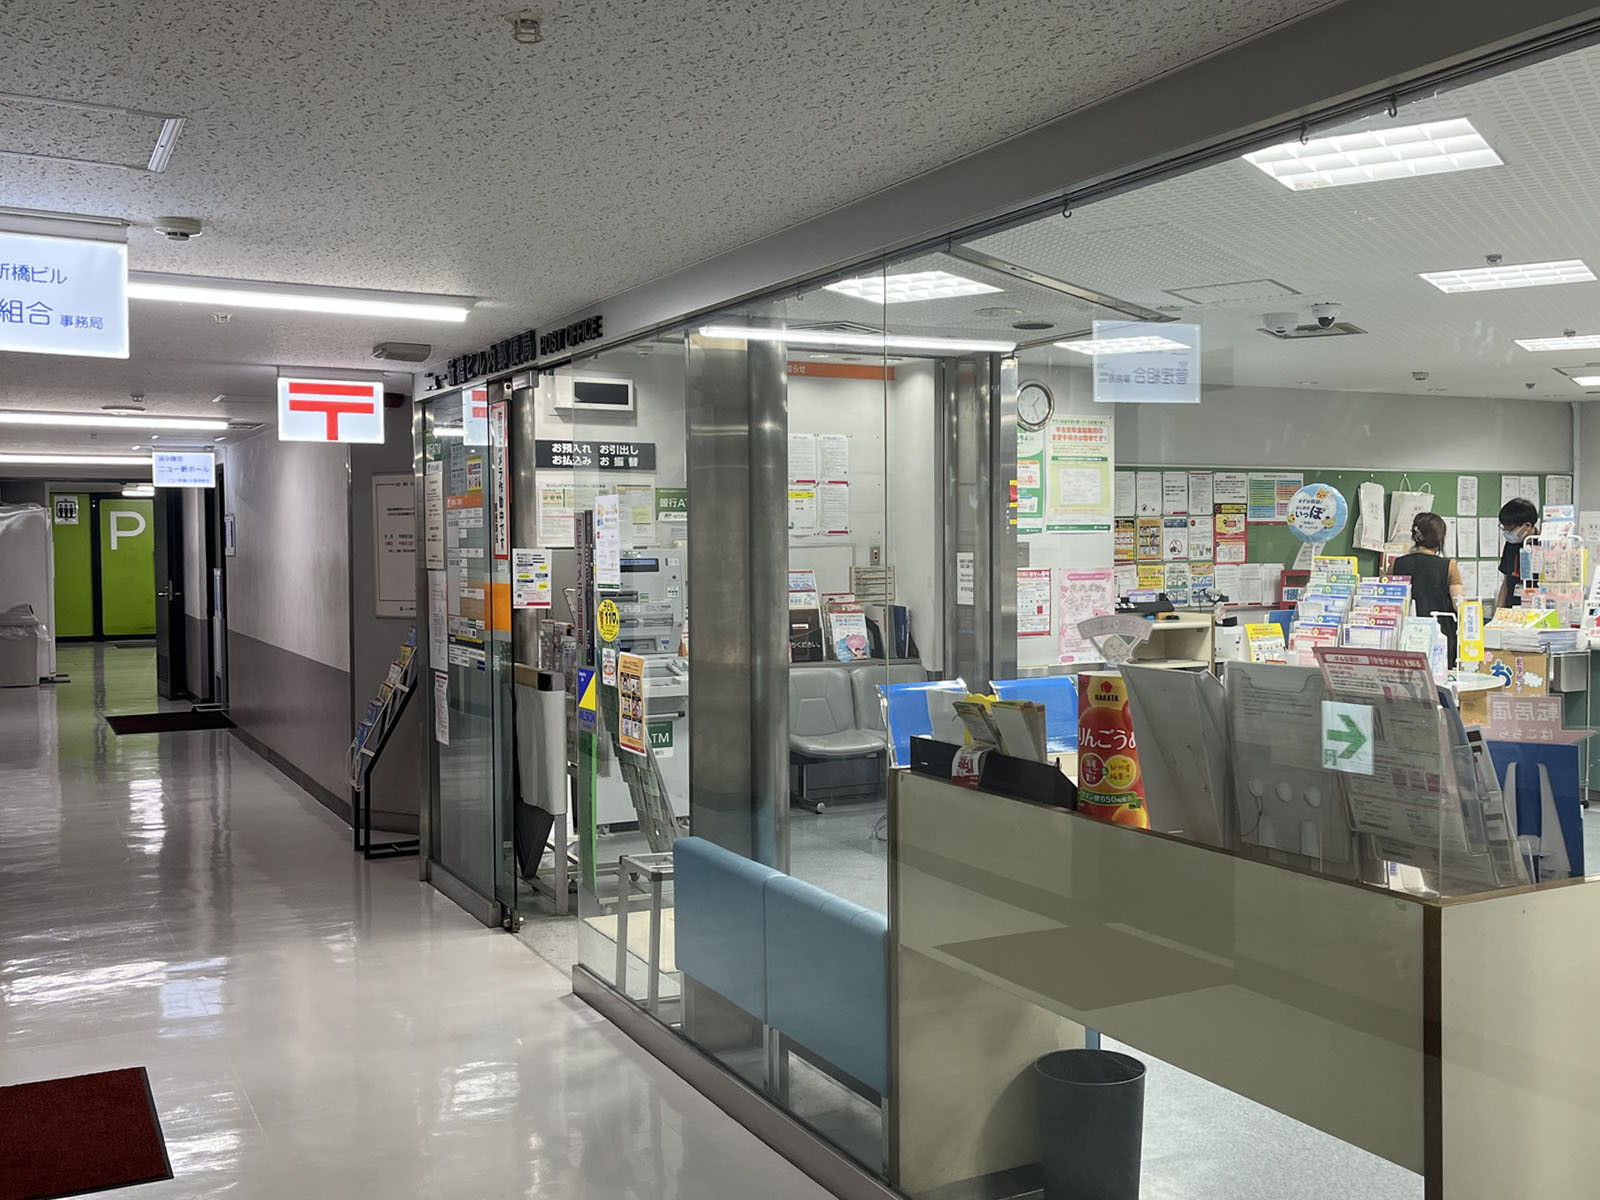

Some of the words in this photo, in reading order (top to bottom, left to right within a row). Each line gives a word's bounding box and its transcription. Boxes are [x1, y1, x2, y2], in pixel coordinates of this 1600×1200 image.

[0, 299, 53, 325] 組合
[60, 314, 104, 330] 事務局
[551, 443, 592, 454] お預入れ
[599, 444, 639, 455] お引出し
[551, 455, 592, 466] お払込み
[599, 456, 639, 467] お振替
[659, 497, 687, 508] 銀行A
[110, 511, 146, 551] P
[650, 732, 669, 744] TM
